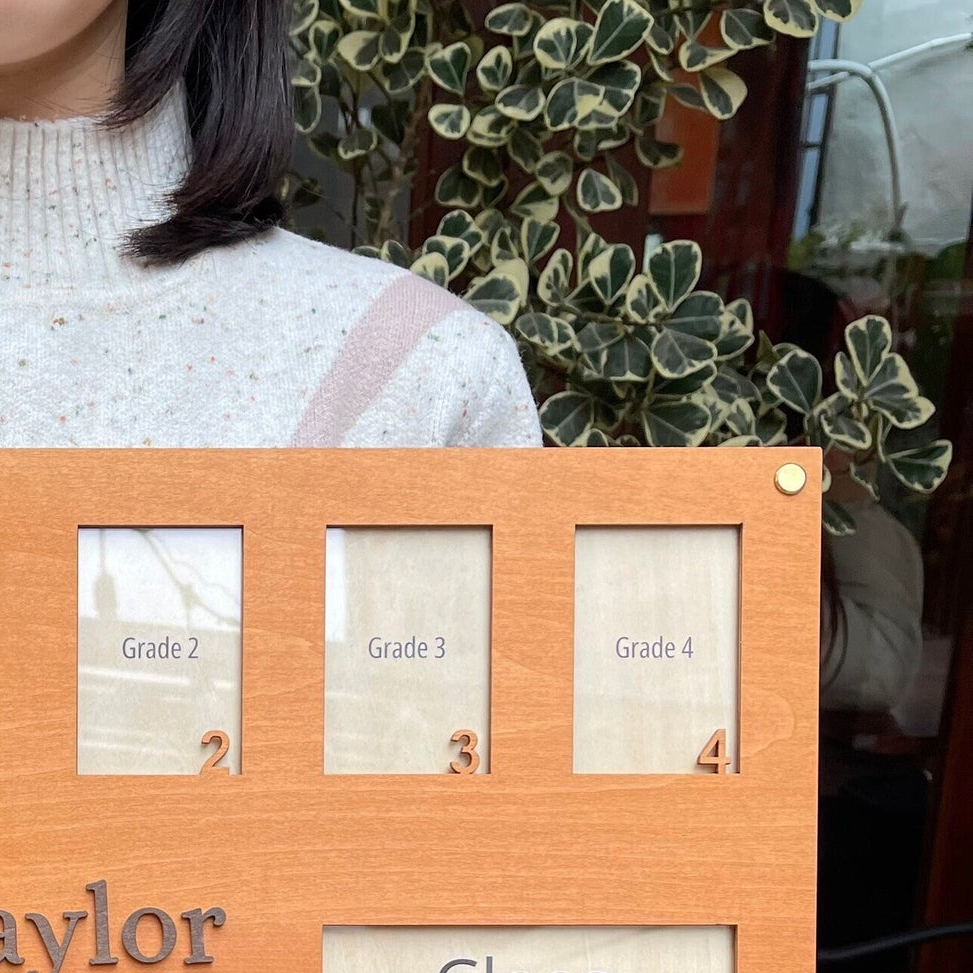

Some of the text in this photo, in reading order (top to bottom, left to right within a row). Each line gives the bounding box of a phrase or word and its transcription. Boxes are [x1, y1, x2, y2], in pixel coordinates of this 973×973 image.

[122, 637, 199, 659] Grade 2
[368, 636, 446, 659] Grade 3
[615, 636, 694, 659] Grade 4
[199, 730, 230, 774] 2
[449, 729, 480, 774] 3
[697, 728, 731, 773] 4
